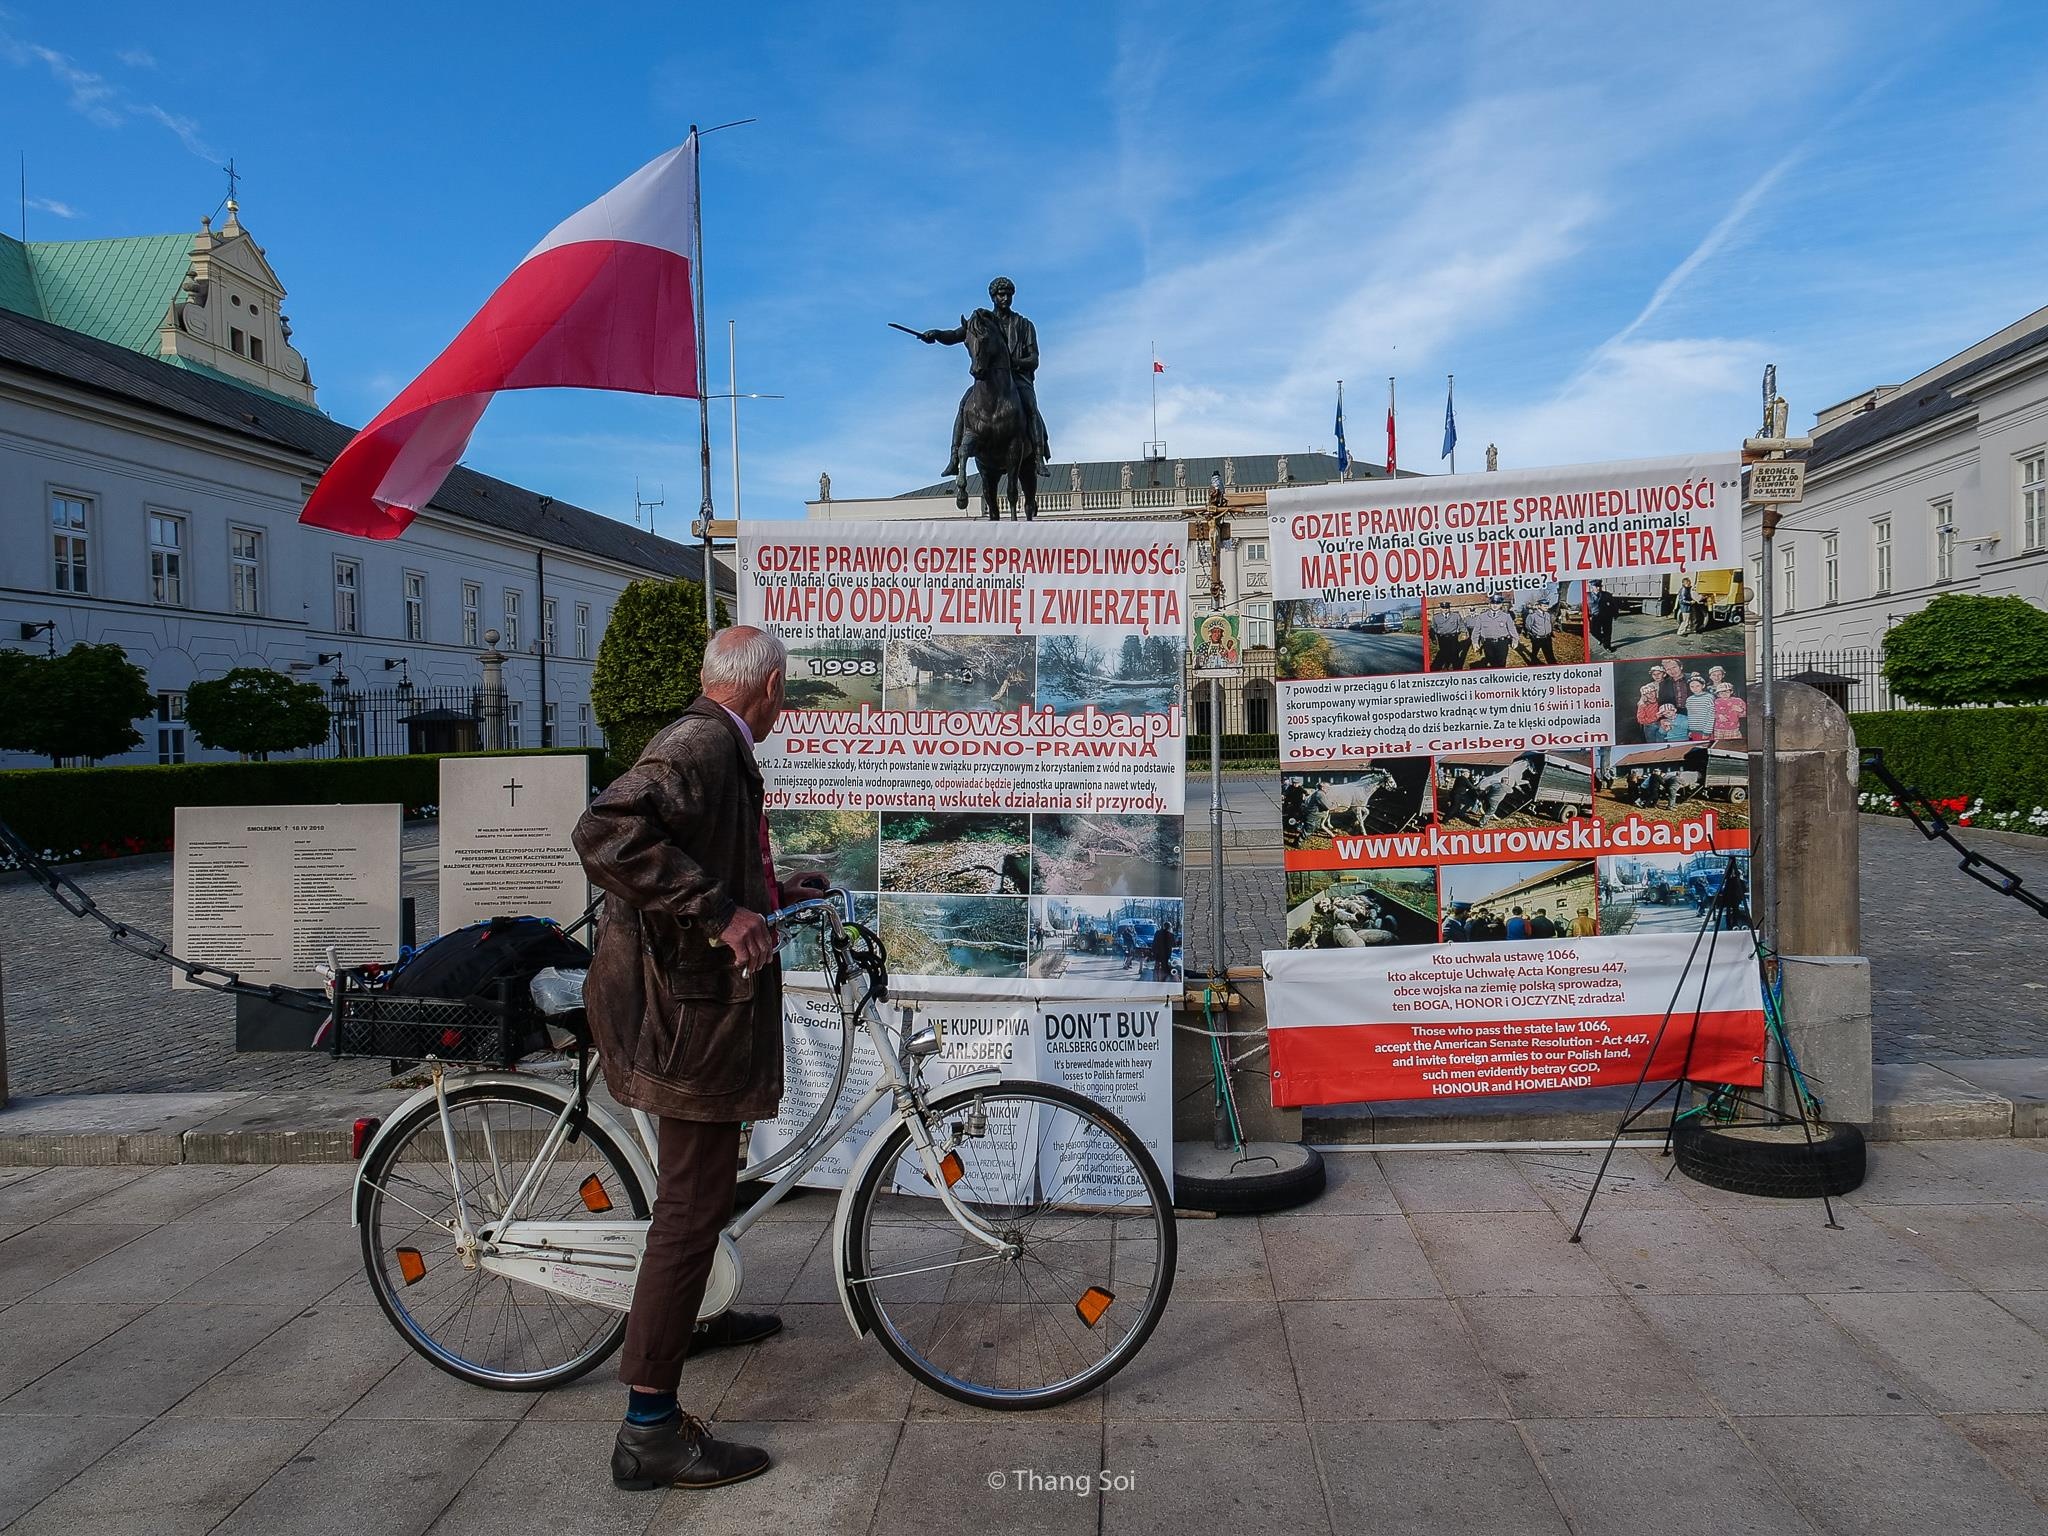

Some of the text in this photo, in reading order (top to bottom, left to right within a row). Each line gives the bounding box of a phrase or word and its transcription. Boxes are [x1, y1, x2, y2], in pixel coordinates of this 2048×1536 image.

[1291, 477, 1714, 540] GDZIE PRAWO! GDZIE SPRAWIEDLIWOŚĆ!
[1368, 534, 1414, 550] Mafia!
[1418, 531, 1452, 546] Give
[1458, 532, 1474, 544] us
[1478, 526, 1515, 542] back
[1518, 525, 1546, 539] our
[1550, 520, 1584, 537] land
[1588, 518, 1618, 534] and
[1623, 512, 1690, 532] animals!
[757, 543, 1180, 575] GDZIE PRAWO! GDZIE SPRAWIEDLIWOŚĆ!
[1302, 526, 1718, 590] MAFIO ODDAJ ZIEMIĘ I ZWIERZĘTA
[790, 572, 825, 587] Mafia!
[828, 573, 854, 587] Give
[856, 576, 869, 588] us
[871, 573, 898, 588] back
[901, 576, 922, 588] our
[923, 573, 950, 588] land
[952, 574, 974, 588] and
[976, 574, 1025, 589] animals!
[1322, 574, 1548, 603] Where is that law and justice?
[764, 588, 1181, 635] MAFIO ODDAJ ZIEMIĘ I ZWIERZĘTA
[766, 624, 932, 644] Where is that law and justice?
[811, 659, 877, 675] 1998
[1288, 715, 1309, 724] 2005
[1312, 712, 1370, 724] spacyfikował
[1372, 709, 1438, 722] gospodarstwo
[1440, 706, 1478, 718] kradnąc
[1490, 706, 1508, 717] tym
[1510, 702, 1531, 712] dniu
[1534, 702, 1544, 711] 16
[1547, 700, 1568, 710] świń
[1571, 700, 1574, 709] i
[1577, 700, 1580, 708] 1
[1584, 698, 1613, 708] konia.
[786, 739, 1158, 757] DECYZJA WODNO-PRAWNA
[1290, 746, 1336, 759] obcy
[1342, 740, 1412, 757] kapitał
[1428, 736, 1525, 751] Carlsberg
[1531, 732, 1608, 746] Okocim
[764, 789, 1167, 812] gdy szkody te powstaną wskutek działania sił przyrody.
[1336, 814, 1713, 860] www.knurowski.cba.pl
[1432, 950, 1579, 964] Kto uchwala ustawę 1066,
[1392, 992, 1625, 1013] ten BOGA, HONOR i OJCZYZNĘ zdradza!
[784, 1013, 840, 1030] Niegodni
[952, 1019, 1030, 1036] KUPUJ PIWA
[1117, 1012, 1159, 1038] BUY
[1412, 1020, 1610, 1038] Those who pass the state law 1066,
[939, 1042, 1012, 1060] CARLSBERG
[1046, 1040, 1159, 1053] CARLSBERG OKOCIM beer!
[1066, 1059, 1113, 1069] brewed/made
[1115, 1058, 1130, 1068] with
[1132, 1058, 1152, 1069] heavy
[1422, 1063, 1600, 1080] such men evidently betray GOD,
[1062, 1070, 1144, 1080] losses to Polish farmers!
[1432, 1077, 1592, 1094] HONOUR and HOMELAND!
